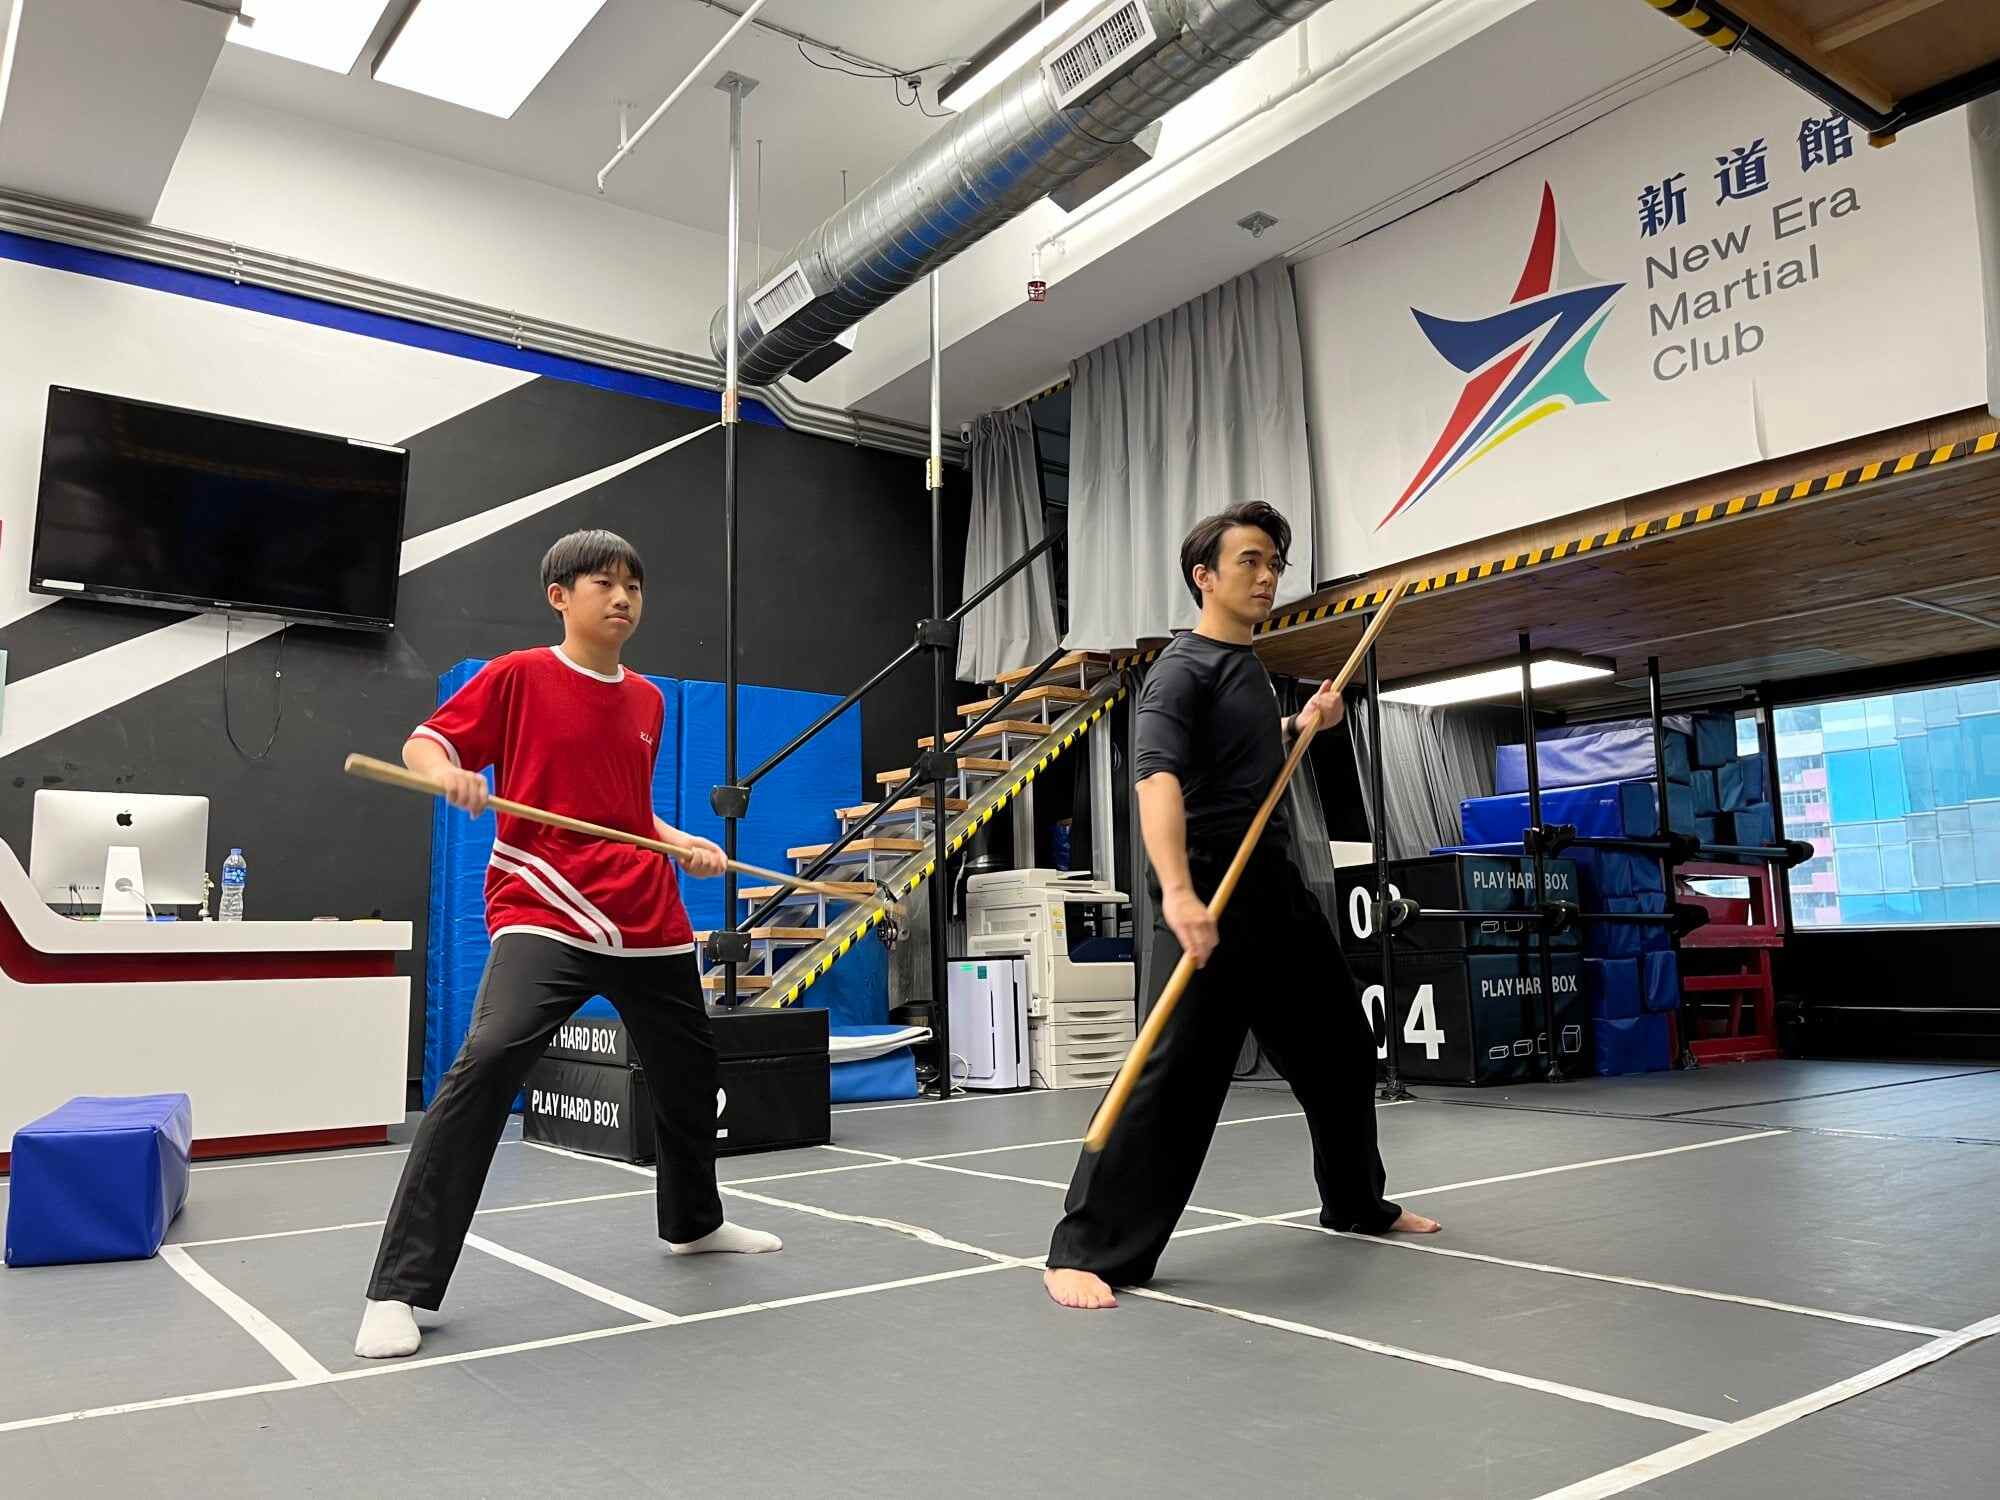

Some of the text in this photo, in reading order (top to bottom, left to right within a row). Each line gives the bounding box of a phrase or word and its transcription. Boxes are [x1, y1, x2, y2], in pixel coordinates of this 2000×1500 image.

[1637, 110, 1854, 240] 新道館
[1646, 187, 1861, 290] New Era
[1650, 244, 1819, 337] Martial
[1653, 321, 1764, 381] Club
[1473, 871, 1569, 890] PLAY HAR BOX
[1349, 883, 1401, 939] 0
[1481, 975, 1578, 998] PLAY HAR BOX
[560, 1025, 590, 1051] HARD
[592, 1028, 617, 1055] BOX
[531, 1089, 619, 1128] PLAY HARD BOX
